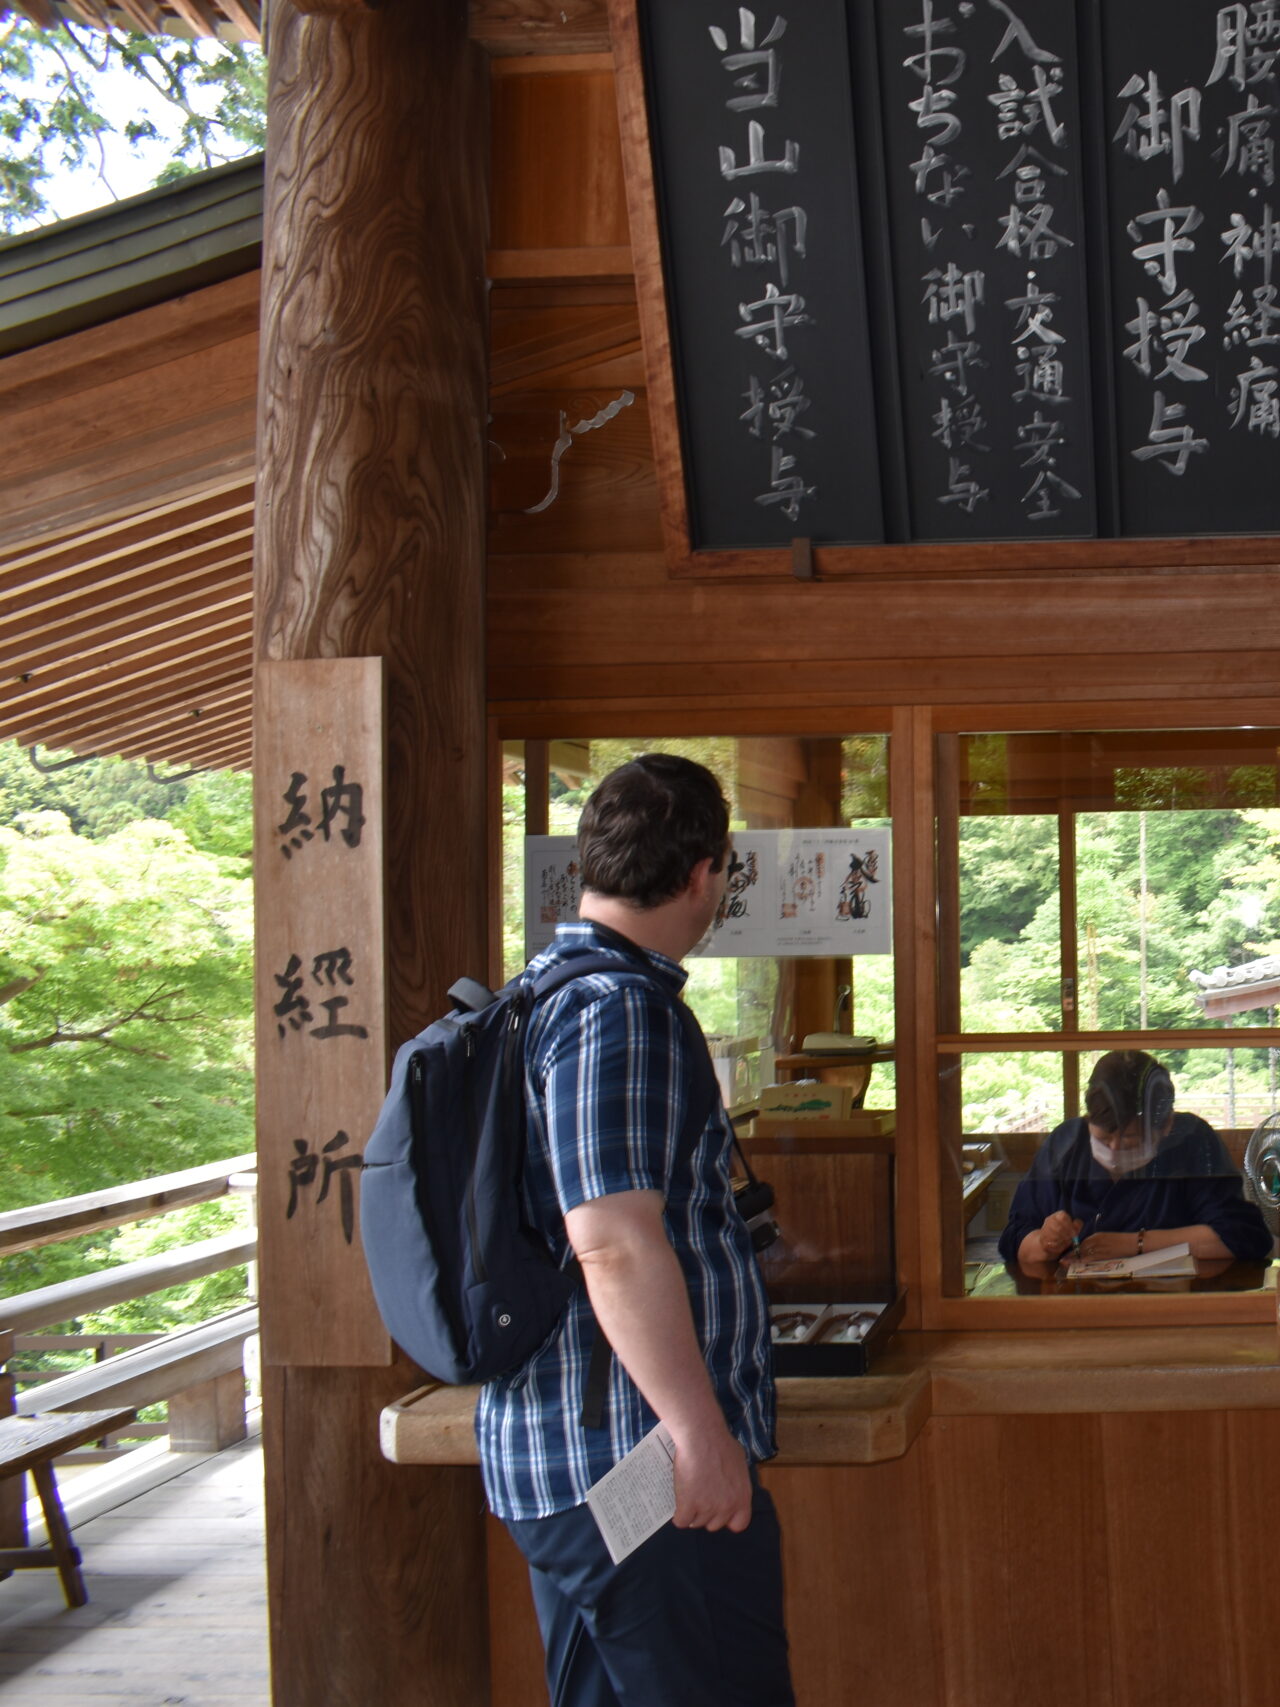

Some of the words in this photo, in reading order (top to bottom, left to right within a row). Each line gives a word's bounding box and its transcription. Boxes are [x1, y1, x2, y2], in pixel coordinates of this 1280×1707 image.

[708, 6, 818, 522] 当山御守授与
[1112, 69, 1209, 476] 御守授与
[274, 764, 370, 1245] 納經所
